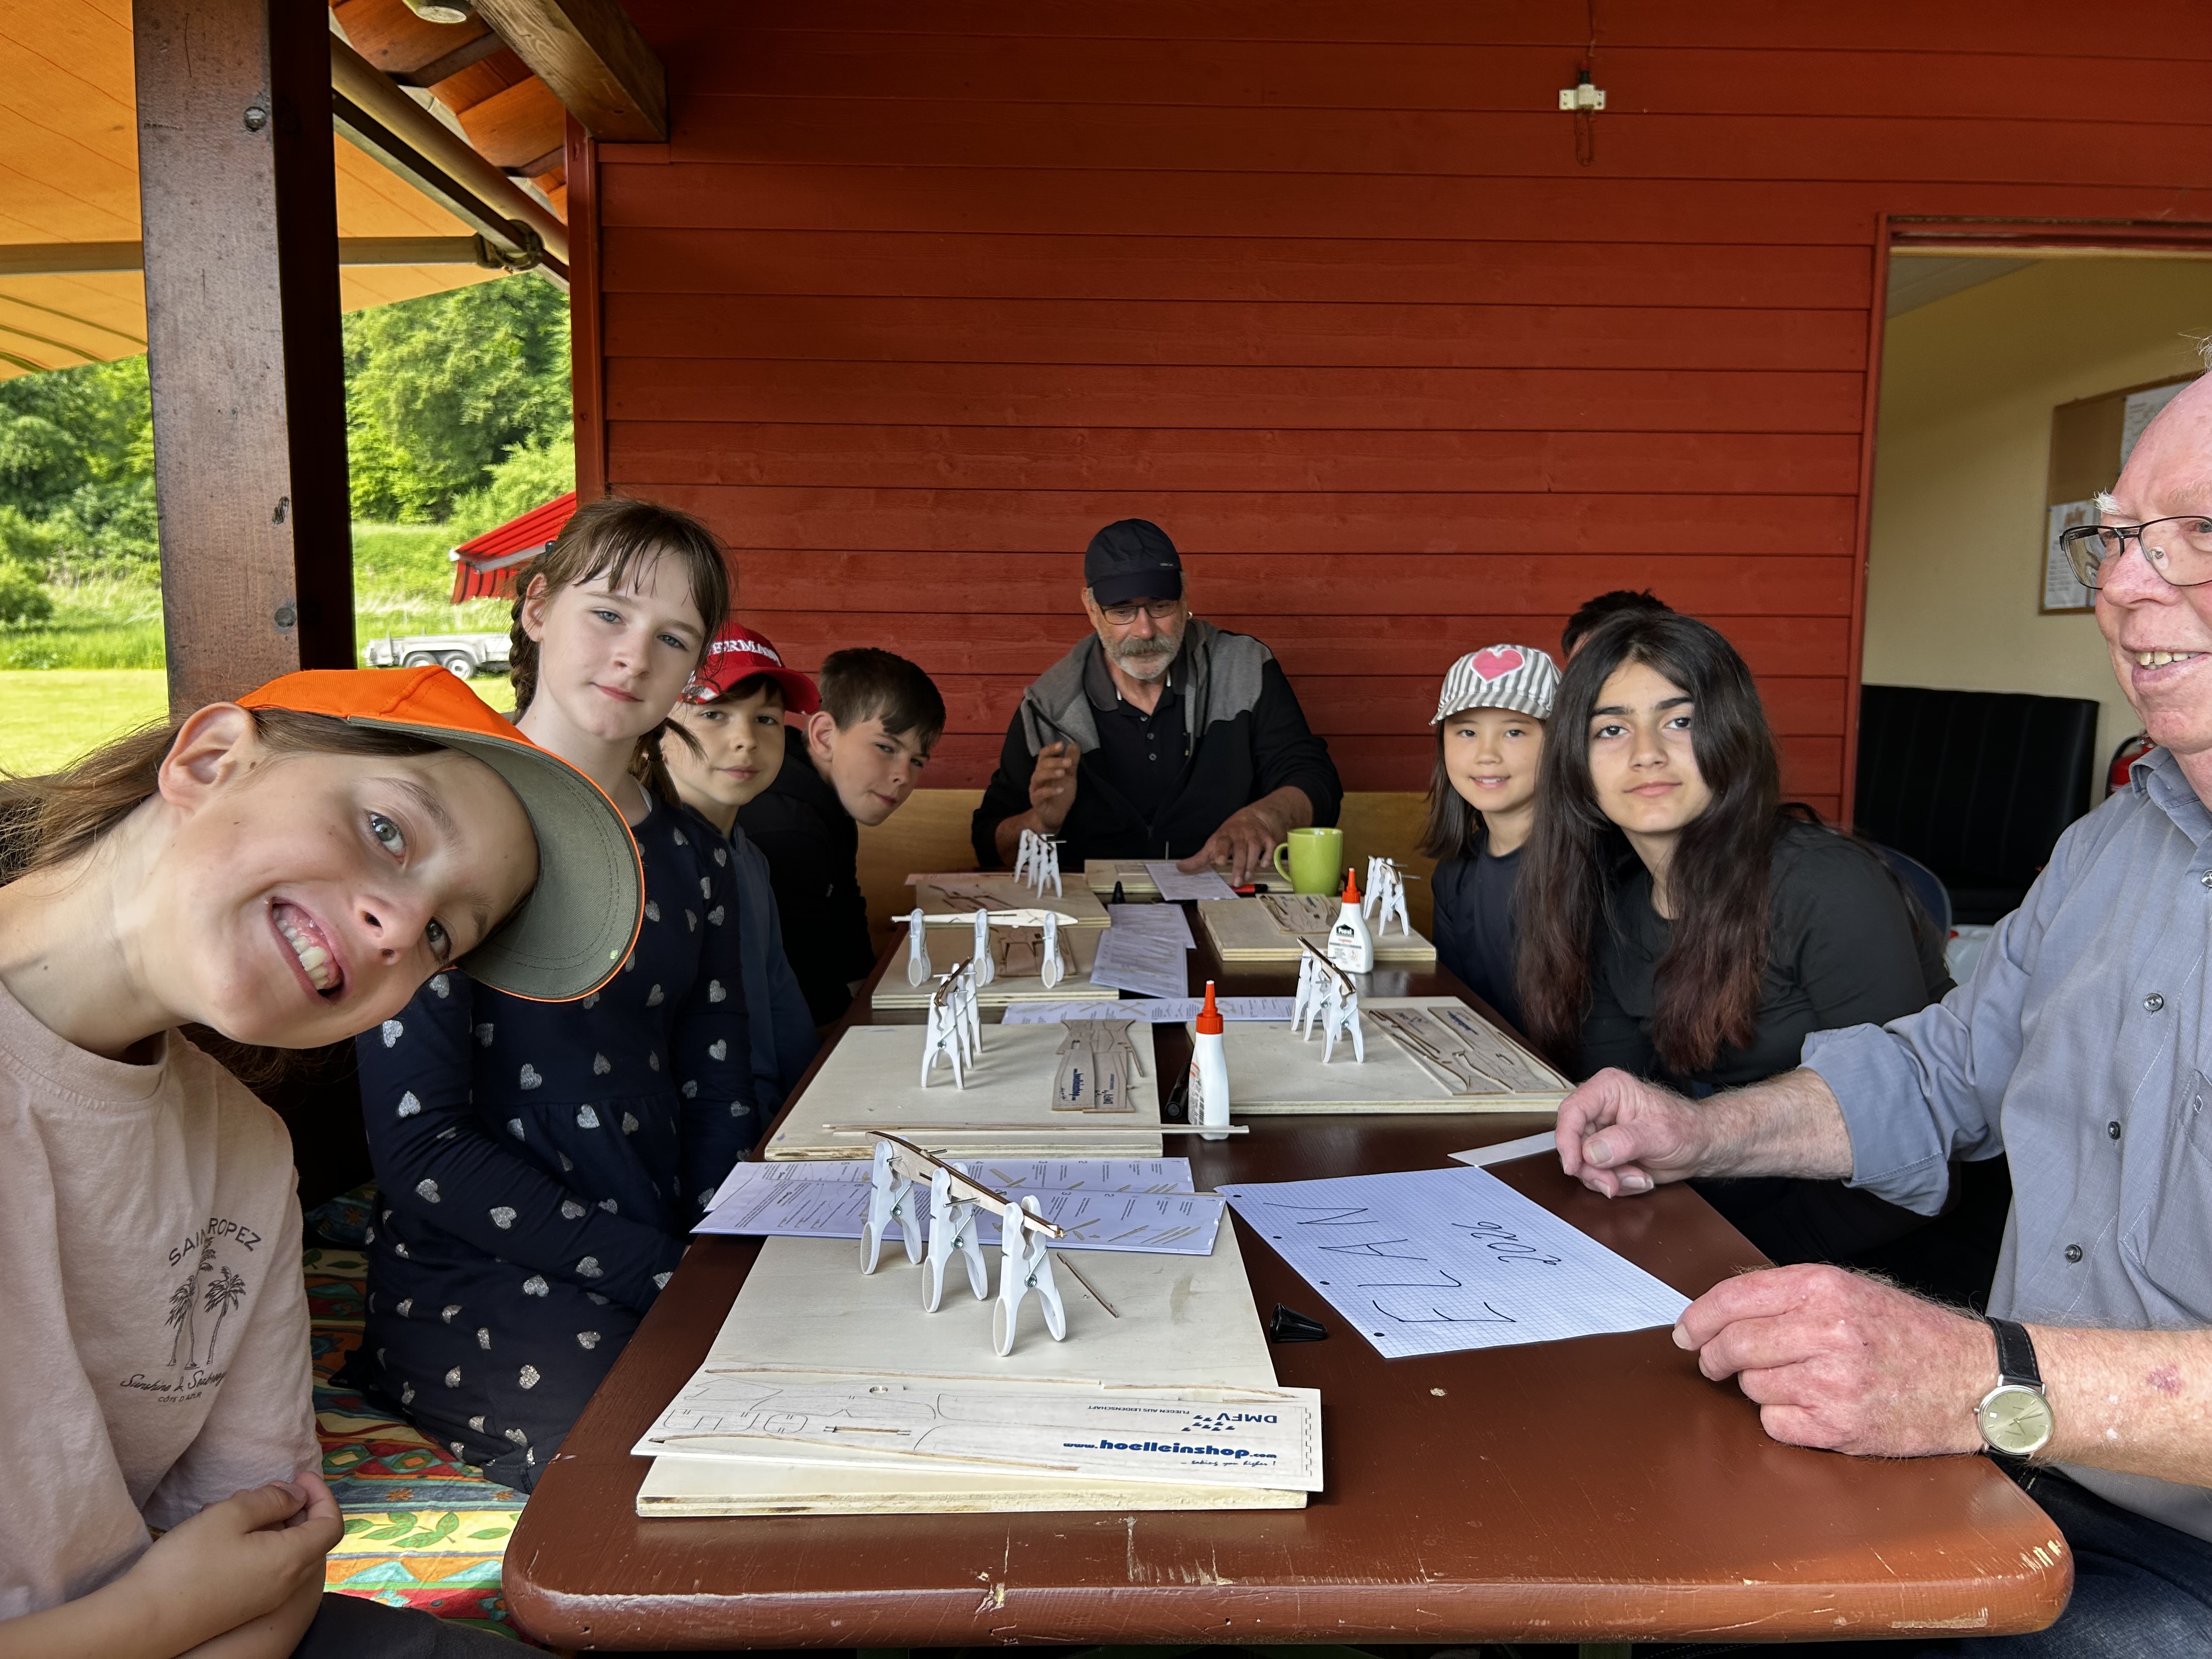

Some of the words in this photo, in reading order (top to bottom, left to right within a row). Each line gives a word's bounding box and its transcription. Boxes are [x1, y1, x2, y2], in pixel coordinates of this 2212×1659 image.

[207, 1217, 262, 1252] ROPEZ
[1262, 1201, 1517, 1323] ELAN
[1217, 1412, 1278, 1424] DMFV
[1063, 1440, 1278, 1459] www.hoelleinshop.com
